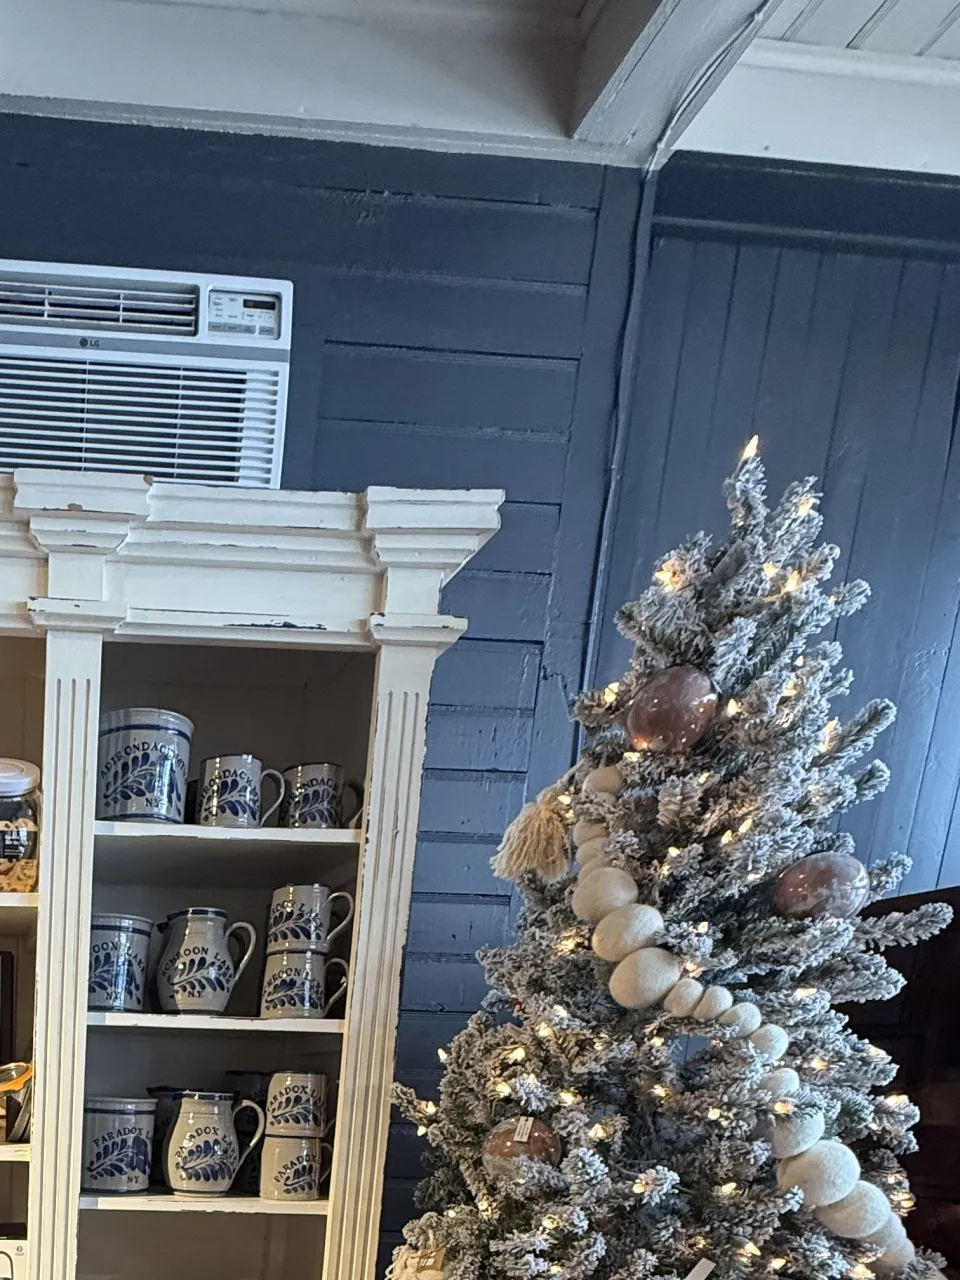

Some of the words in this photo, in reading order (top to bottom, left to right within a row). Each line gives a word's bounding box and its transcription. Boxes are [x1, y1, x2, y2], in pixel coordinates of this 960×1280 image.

[89, 339, 100, 348] LG
[162, 946, 209, 977] SCHROON
[92, 1126, 144, 1148] PARADOX
[174, 1126, 221, 1160] PARADOX
[272, 1154, 316, 1185] PARADOX
